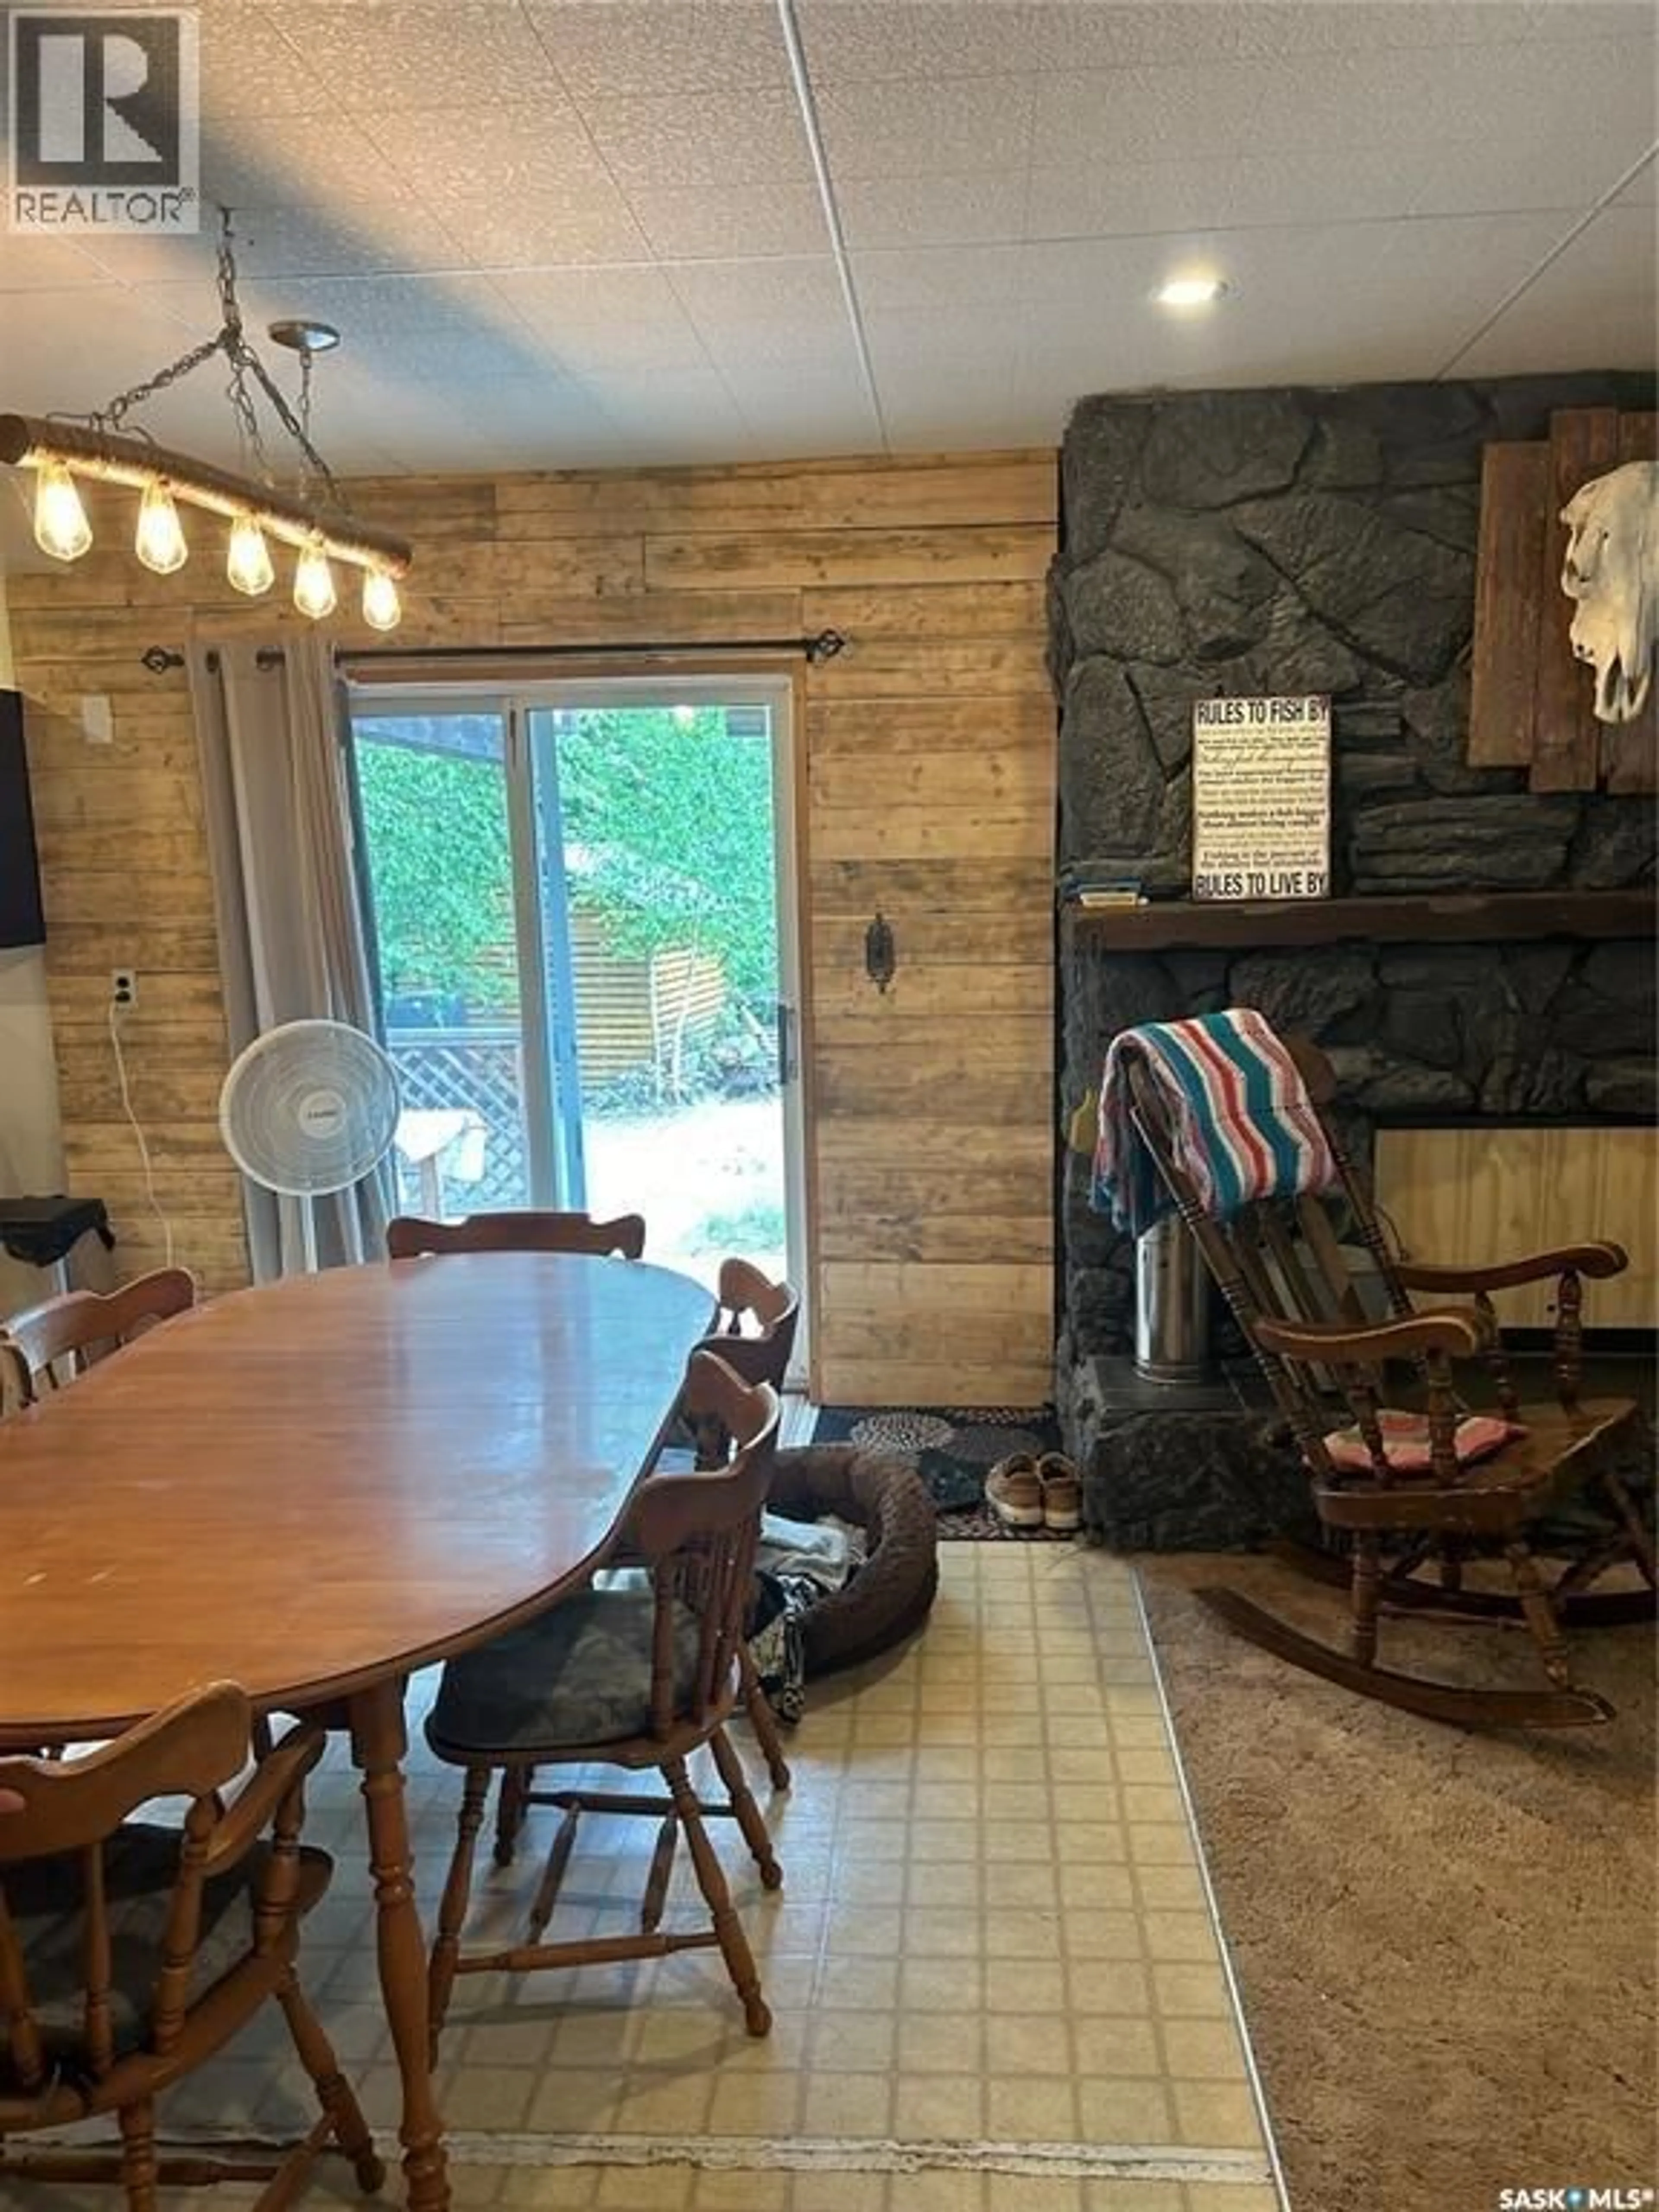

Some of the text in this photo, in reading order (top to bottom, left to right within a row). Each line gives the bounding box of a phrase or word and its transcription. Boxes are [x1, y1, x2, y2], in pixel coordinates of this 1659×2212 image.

[1198, 698, 1328, 724] RULES TO FISH BY
[1195, 872, 1326, 897] RULES TO LIVE BY
